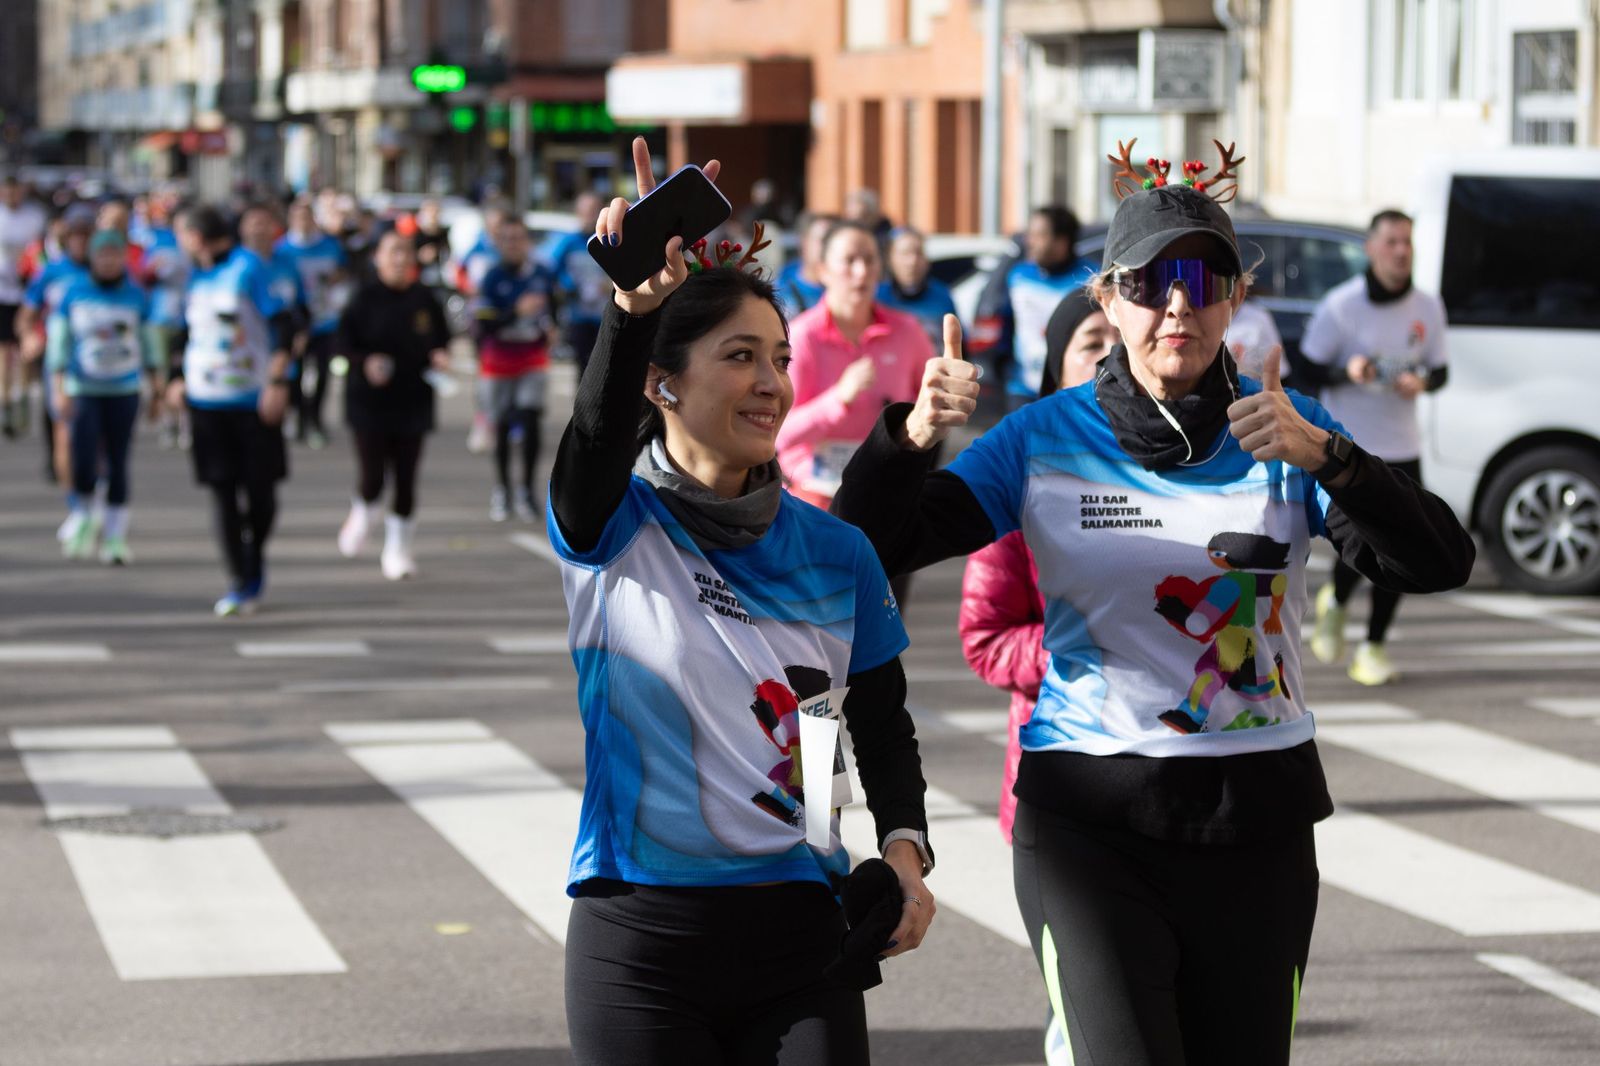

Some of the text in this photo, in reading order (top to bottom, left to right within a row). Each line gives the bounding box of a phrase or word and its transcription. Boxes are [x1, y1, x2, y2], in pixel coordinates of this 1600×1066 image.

[1080, 494, 1128, 504] XLI SAN
[1080, 507, 1141, 517] SILVESTRE
[1081, 519, 1163, 529] SALMANTINA
[694, 572, 730, 592] XLI SA
